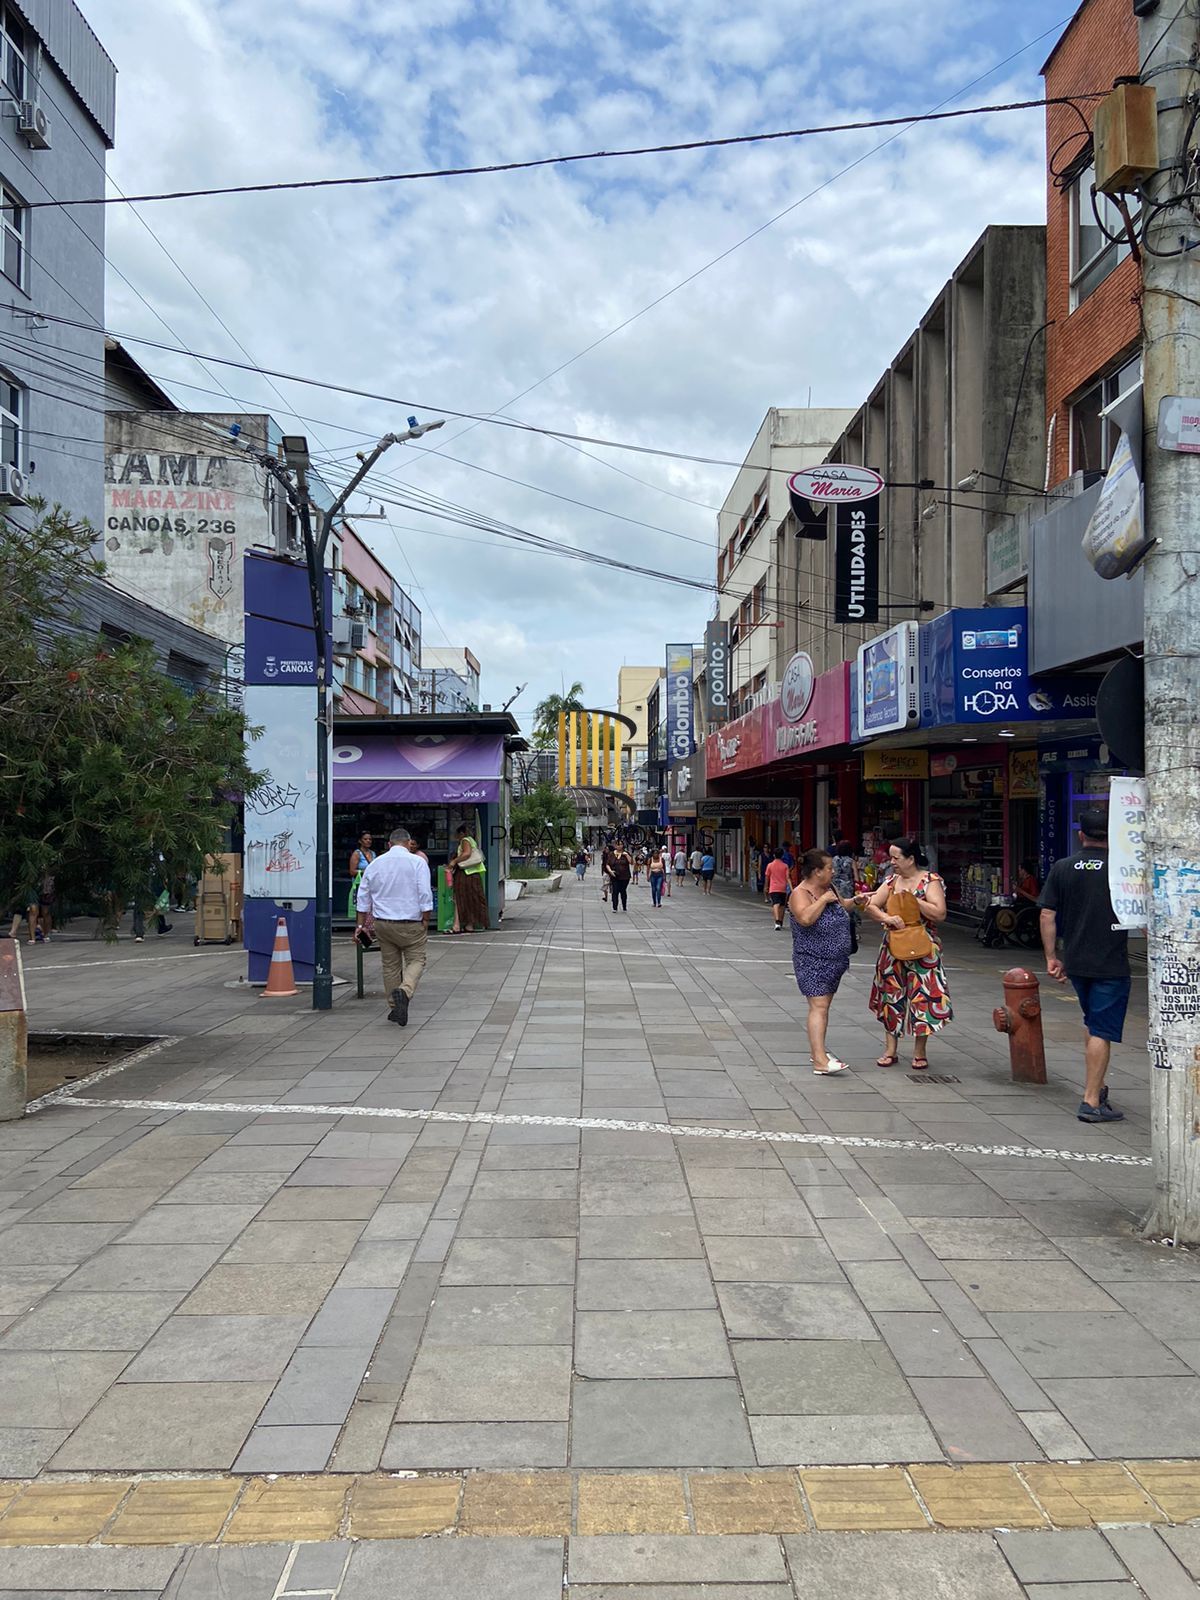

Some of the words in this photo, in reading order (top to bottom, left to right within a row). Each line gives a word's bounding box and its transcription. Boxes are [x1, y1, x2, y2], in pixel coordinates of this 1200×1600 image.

[812, 469, 848, 480] CASA
[810, 481, 862, 496] Maria
[111, 489, 236, 511] MAGAZINE
[197, 519, 236, 534] 236
[848, 510, 866, 618] UTILIDADES
[280, 665, 314, 673] CANOAS
[962, 667, 1022, 679] Consertos
[995, 680, 1013, 690] na
[1062, 694, 1097, 708] Assis
[672, 675, 690, 760] Colombo
[462, 790, 479, 798] vivo
[1163, 968, 1188, 985] 853
